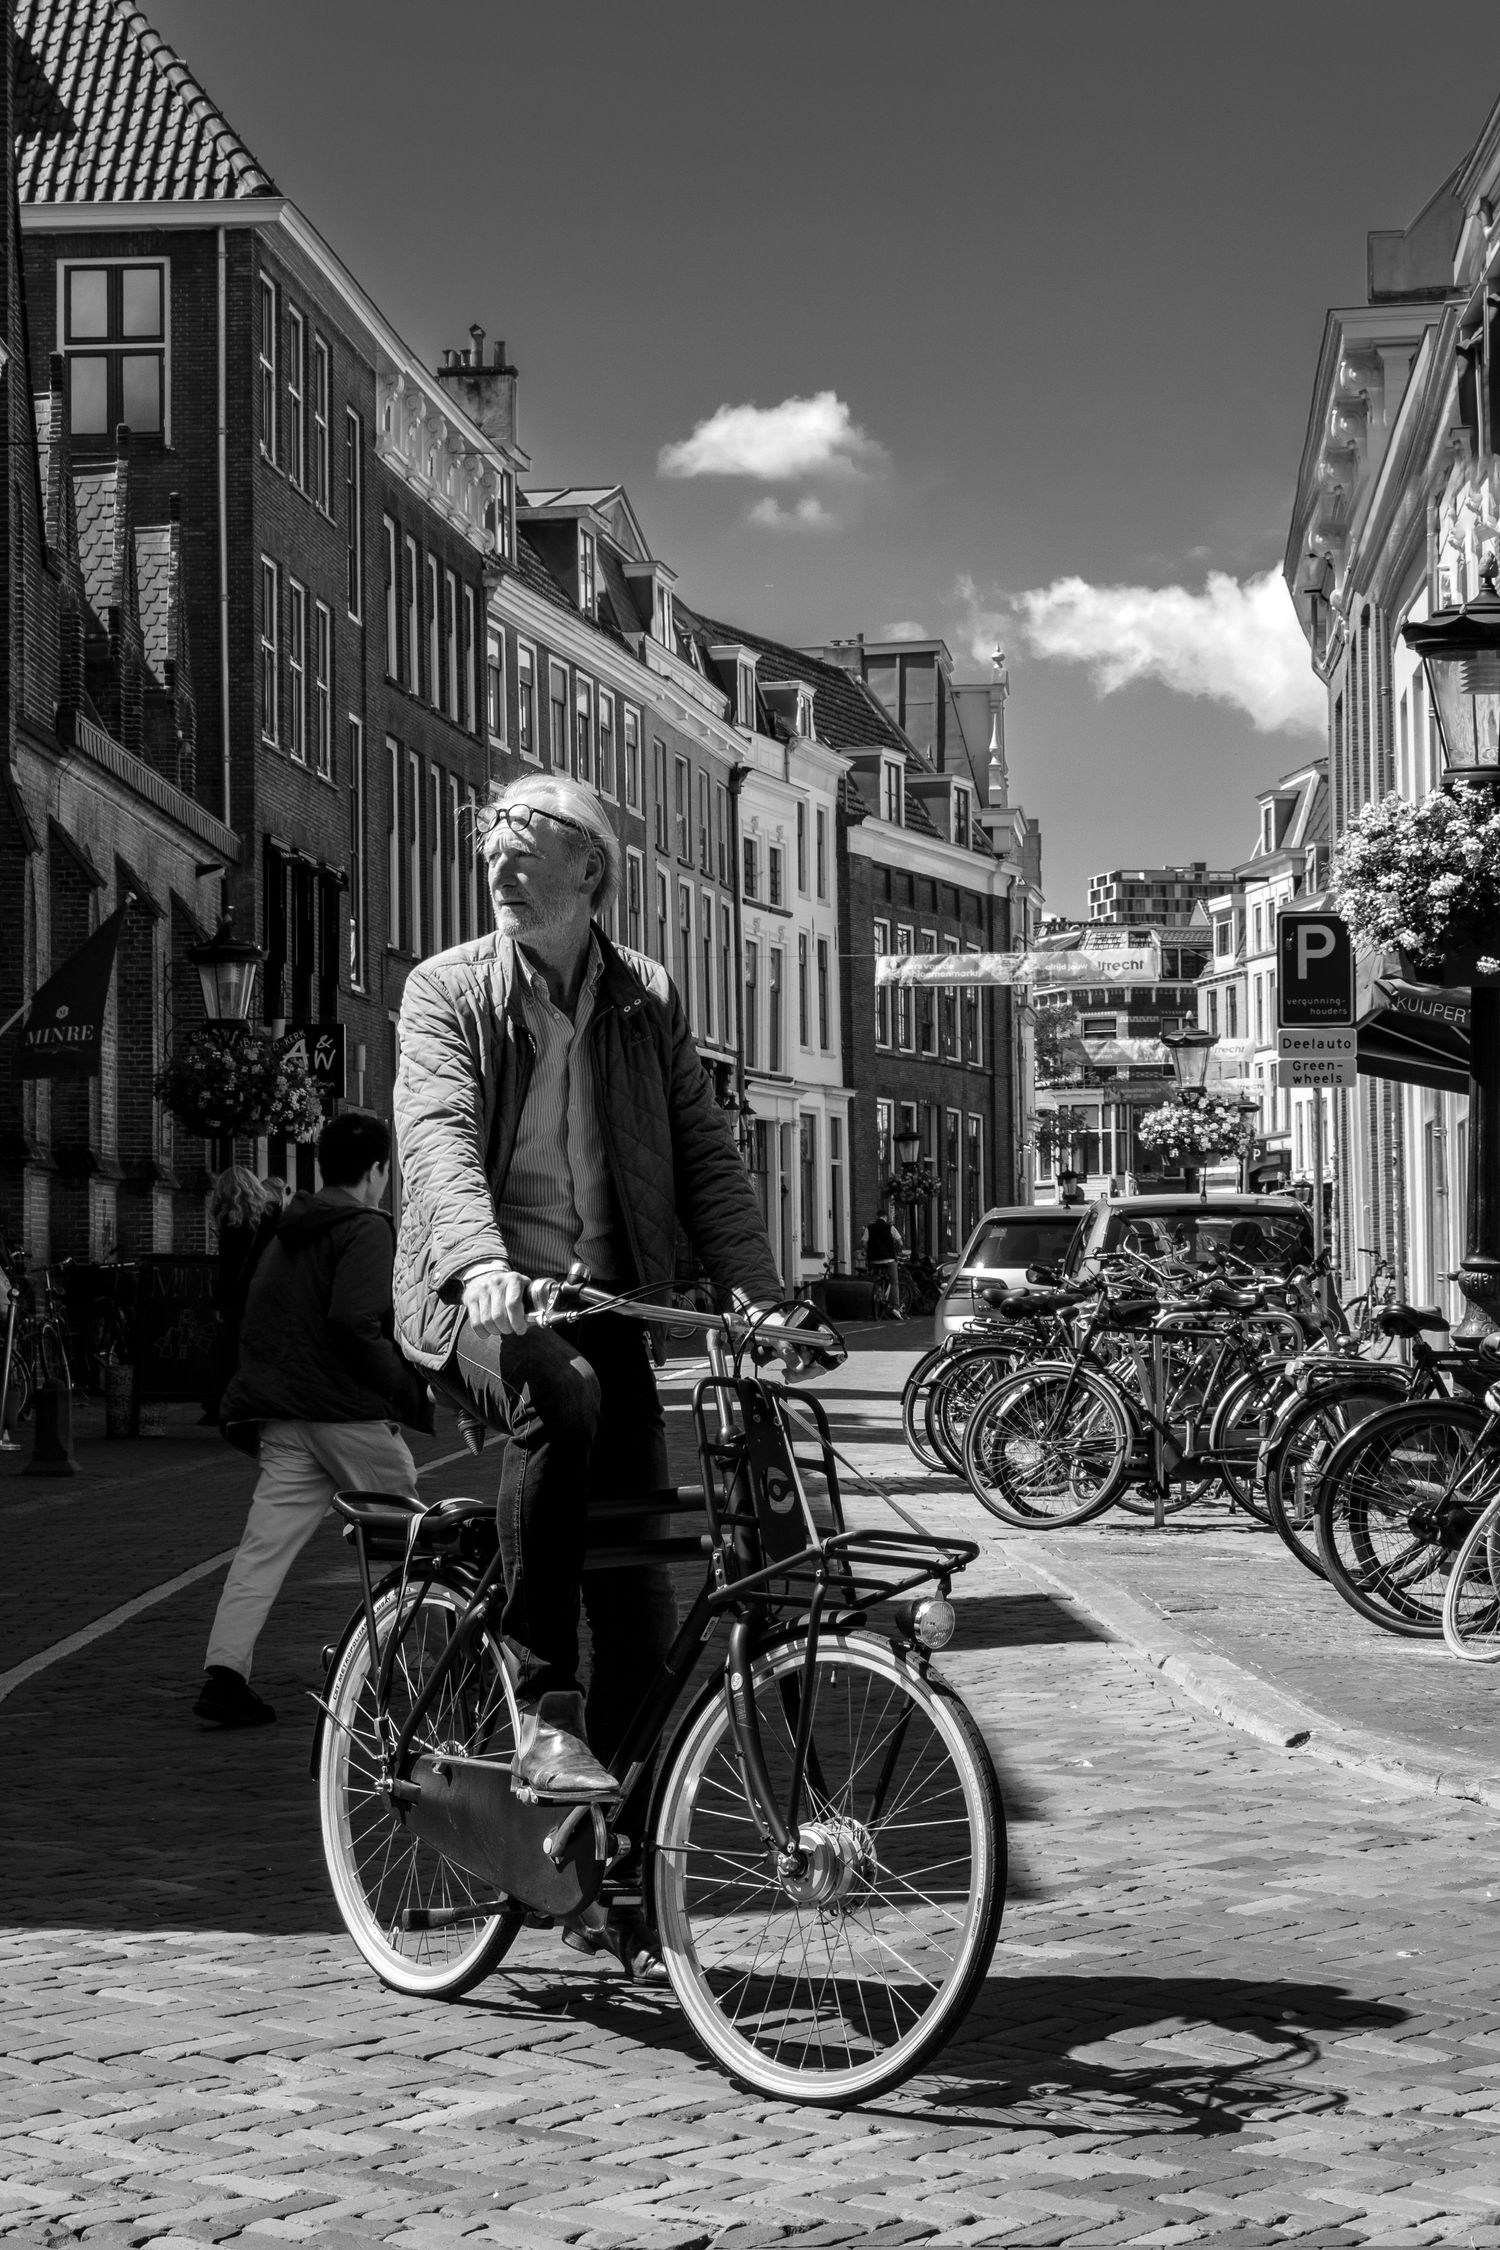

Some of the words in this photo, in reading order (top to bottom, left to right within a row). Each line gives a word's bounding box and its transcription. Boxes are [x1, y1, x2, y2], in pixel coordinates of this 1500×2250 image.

[1297, 924, 1337, 980] P
[1310, 1007, 1348, 1015] houders
[24, 1024, 94, 1046] MINRE
[1283, 1038, 1352, 1049] Deelauto
[1293, 1061, 1344, 1071] Green-
[1293, 1073, 1343, 1083] wheels
[1253, 1148, 1261, 1161] P
